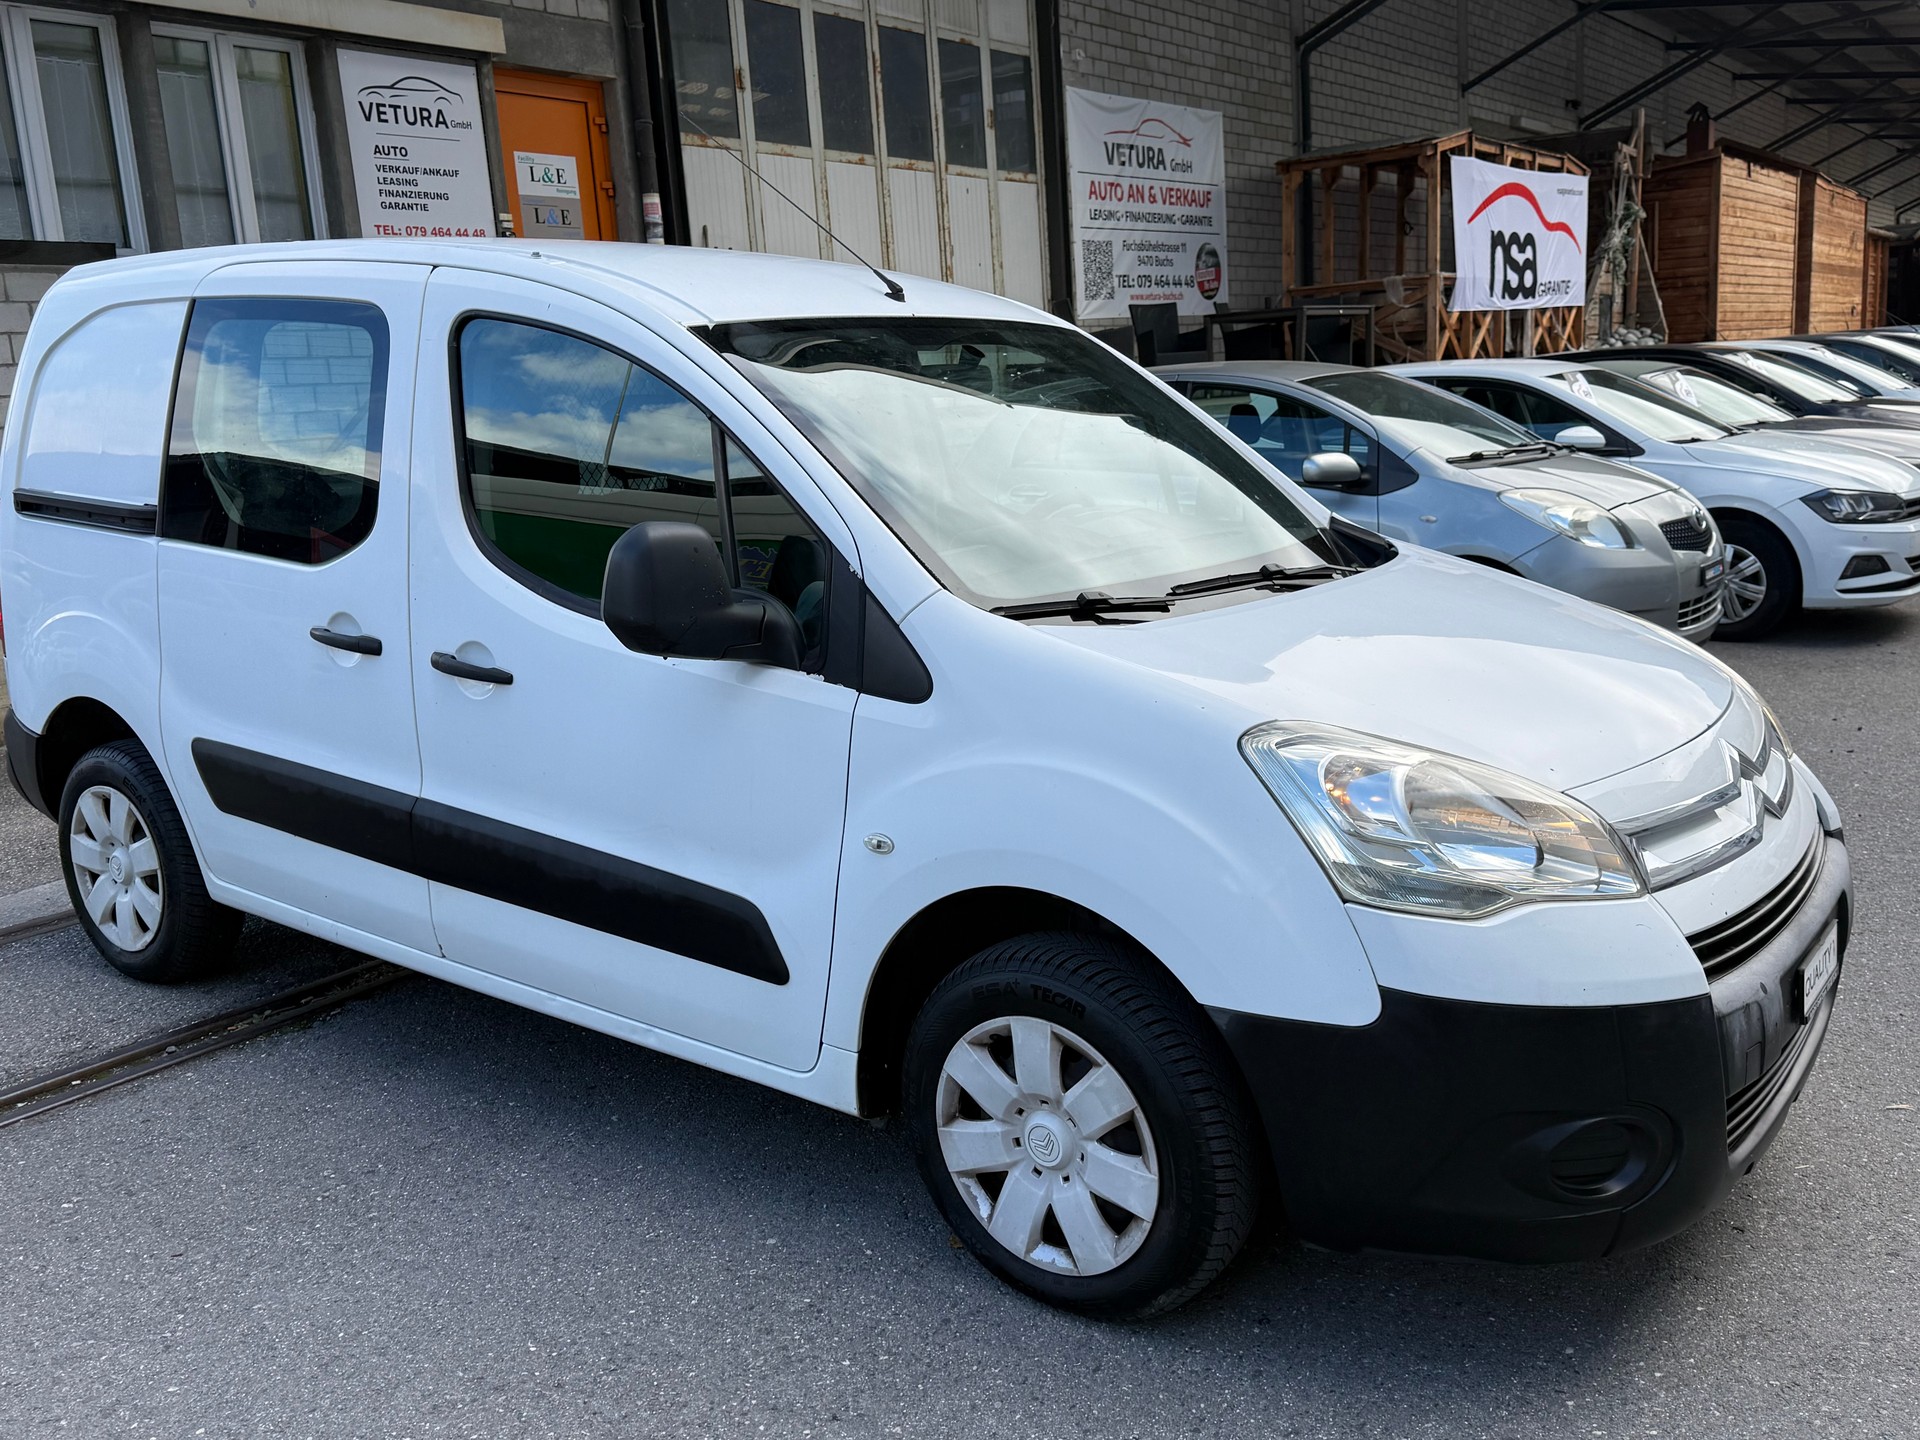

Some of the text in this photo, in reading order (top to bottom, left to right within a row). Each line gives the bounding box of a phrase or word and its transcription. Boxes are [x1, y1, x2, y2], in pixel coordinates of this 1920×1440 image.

[358, 100, 472, 130] VETURA GmbH
[373, 144, 408, 158] AUTO
[1104, 141, 1193, 174] VETURA GmbH
[375, 164, 460, 178] VERKAUF/ANKAUF
[377, 176, 419, 187] LEASING
[378, 188, 450, 201] FINANZIERUNG
[1088, 180, 1212, 208] AUTO AN & VERKAUF
[380, 201, 430, 212] GARANTIE
[1089, 208, 1213, 227] LEASING FINANZIERUNG GARANTIE
[374, 224, 486, 238] TEL: 079 464 44 48
[1137, 255, 1174, 267] 9470 Buchs
[1489, 230, 1537, 300] nsa
[1115, 274, 1135, 288] TEL:
[1137, 274, 1152, 288] 079
[1154, 275, 1171, 288] 464
[1172, 275, 1183, 288] 44
[1184, 275, 1195, 288] 48
[1537, 280, 1571, 297] GARANTIE
[1805, 943, 1832, 997] QUALITY
[1030, 983, 1087, 1019] TECAR
